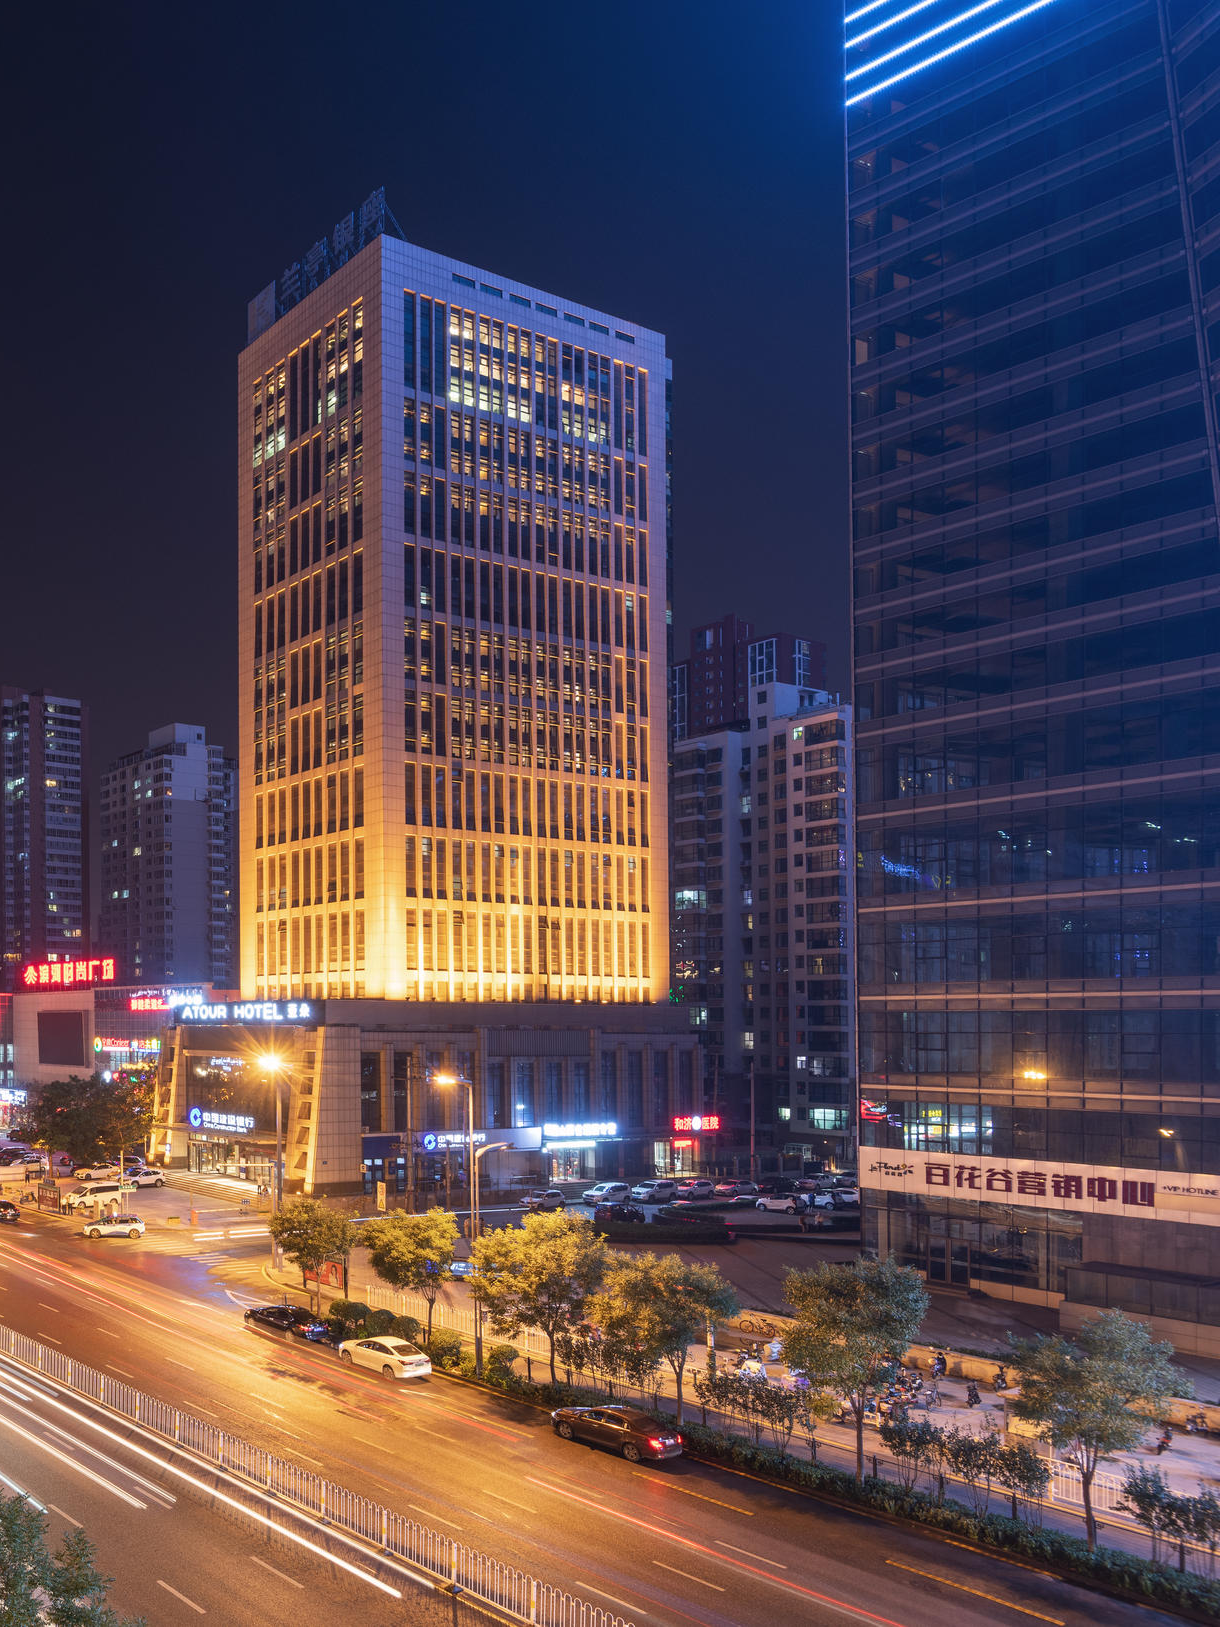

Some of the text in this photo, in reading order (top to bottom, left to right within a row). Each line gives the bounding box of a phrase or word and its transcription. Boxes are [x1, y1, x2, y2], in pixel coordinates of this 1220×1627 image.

[39, 959, 114, 984] 滨河时尚广场
[182, 1003, 310, 1020] ATOUR HOTEL 亚朵
[203, 1112, 254, 1128] 中国建设银行
[924, 1162, 1155, 1208] 百花谷营销中心
[1182, 1187, 1219, 1196] HOTLINE
